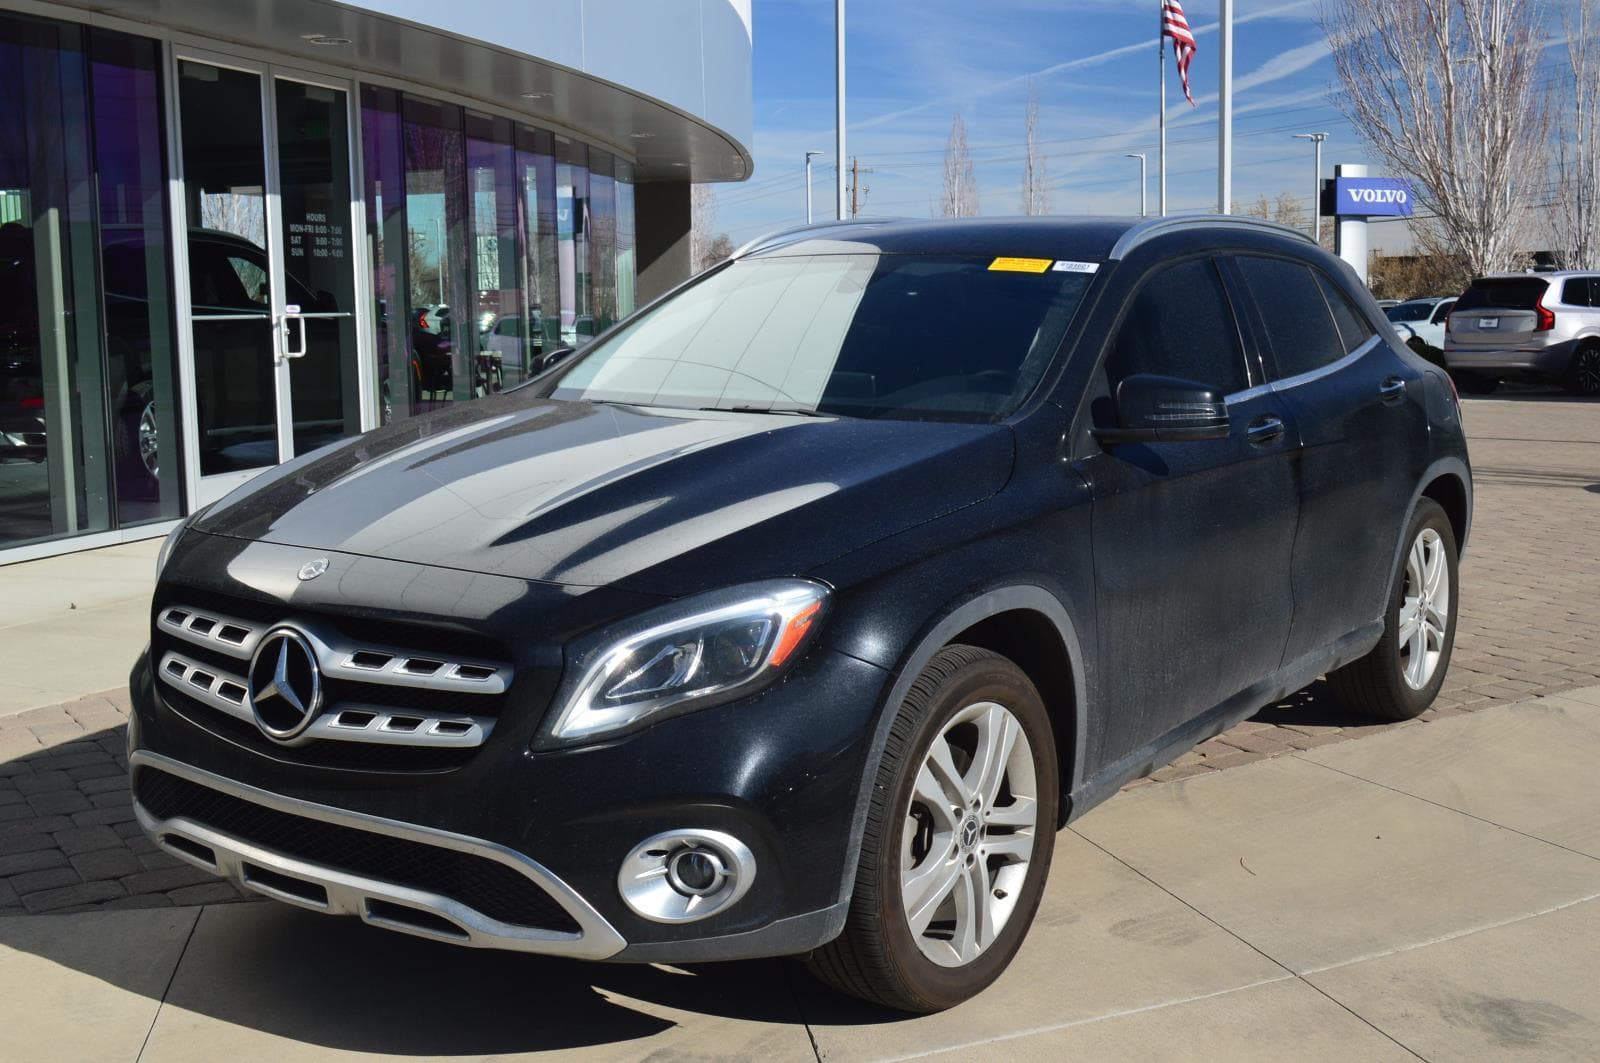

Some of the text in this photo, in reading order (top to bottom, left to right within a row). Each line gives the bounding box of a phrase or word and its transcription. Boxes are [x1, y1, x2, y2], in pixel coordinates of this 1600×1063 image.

[1347, 188, 1407, 204] VOLVO
[306, 213, 326, 222] HOURS
[290, 224, 314, 233] MON-FRI
[291, 236, 302, 244] SAT
[292, 248, 304, 256] SUN
